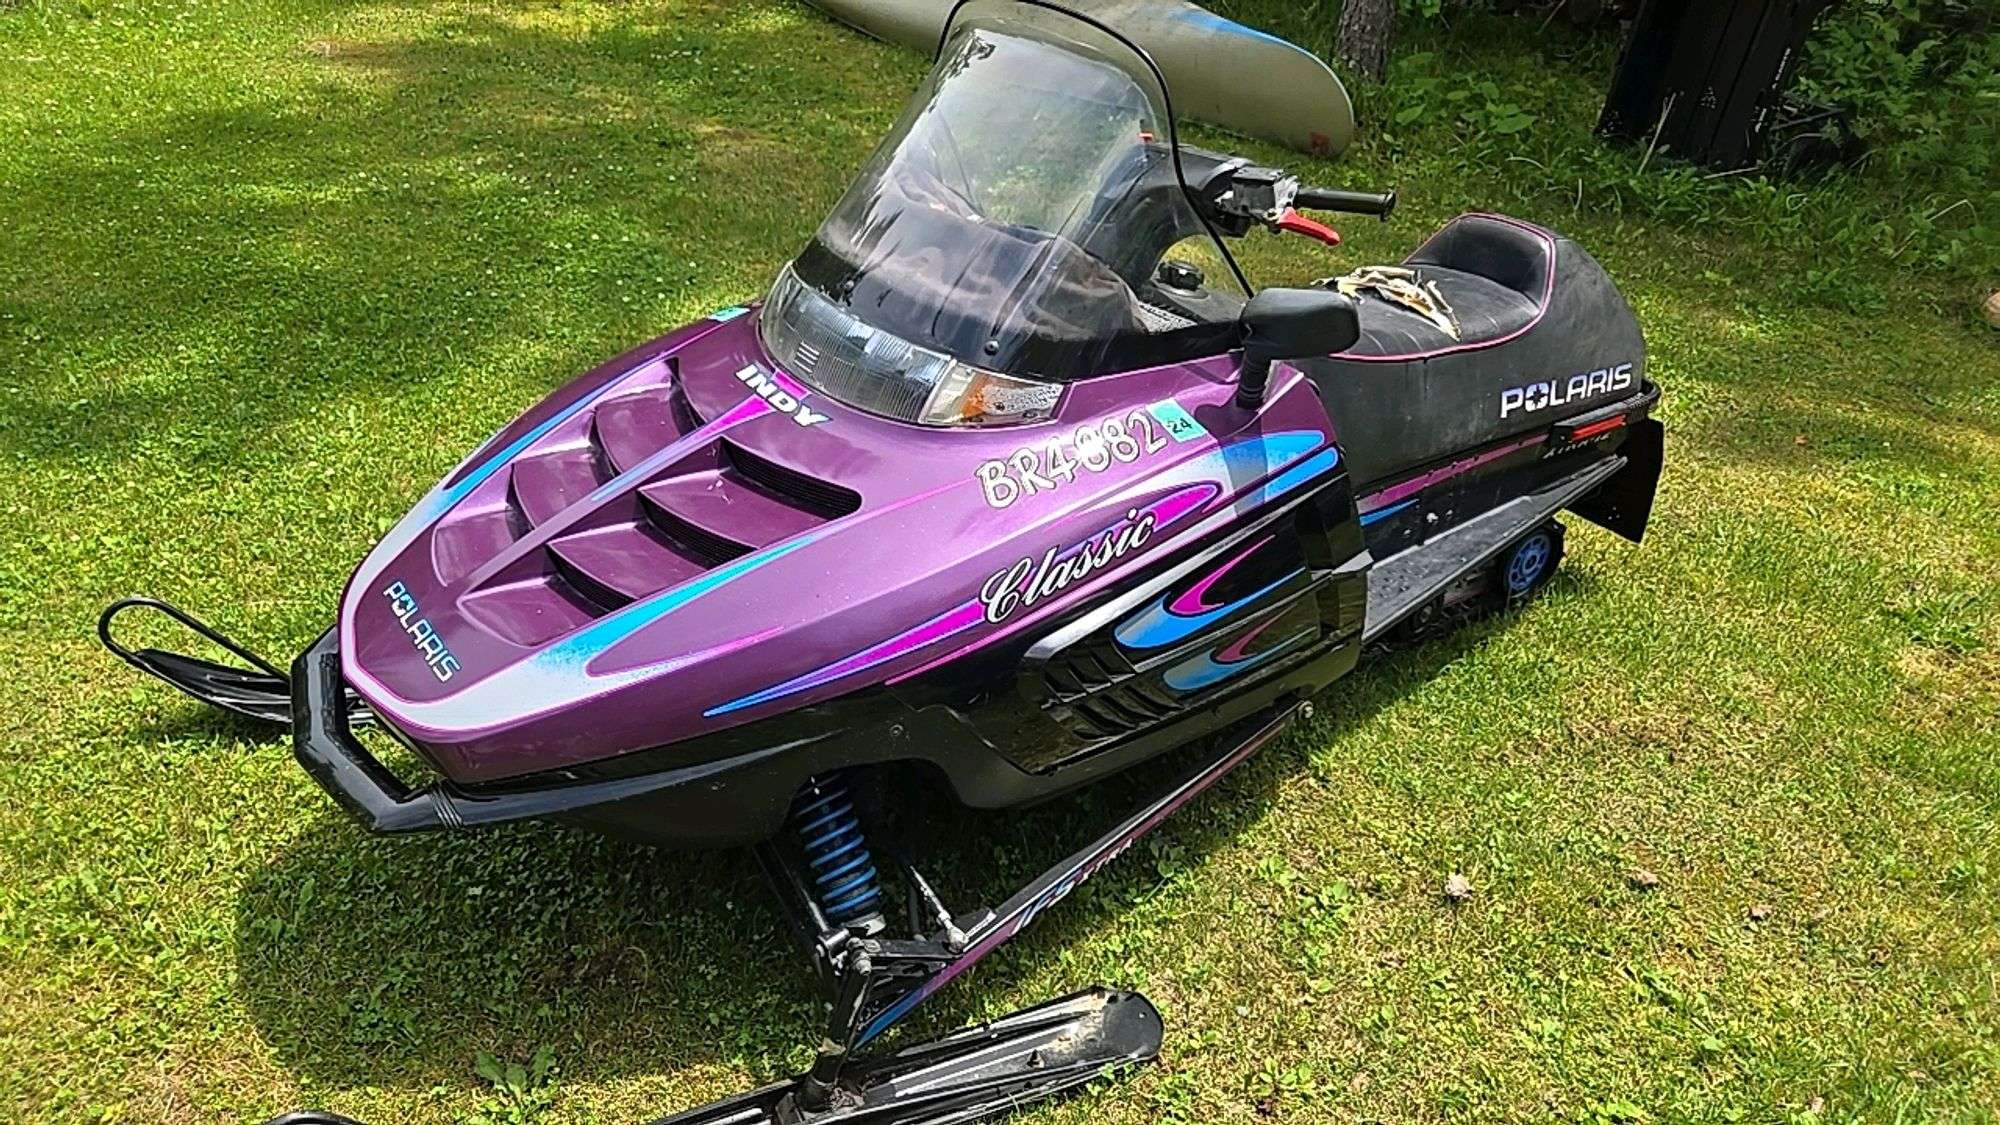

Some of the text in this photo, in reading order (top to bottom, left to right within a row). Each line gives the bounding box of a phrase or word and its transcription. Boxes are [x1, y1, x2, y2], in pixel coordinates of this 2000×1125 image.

[735, 363, 832, 426] INDY
[1500, 362, 1632, 418] POLARIS
[978, 507, 1156, 623] Classic
[382, 581, 461, 682] POLARIS
